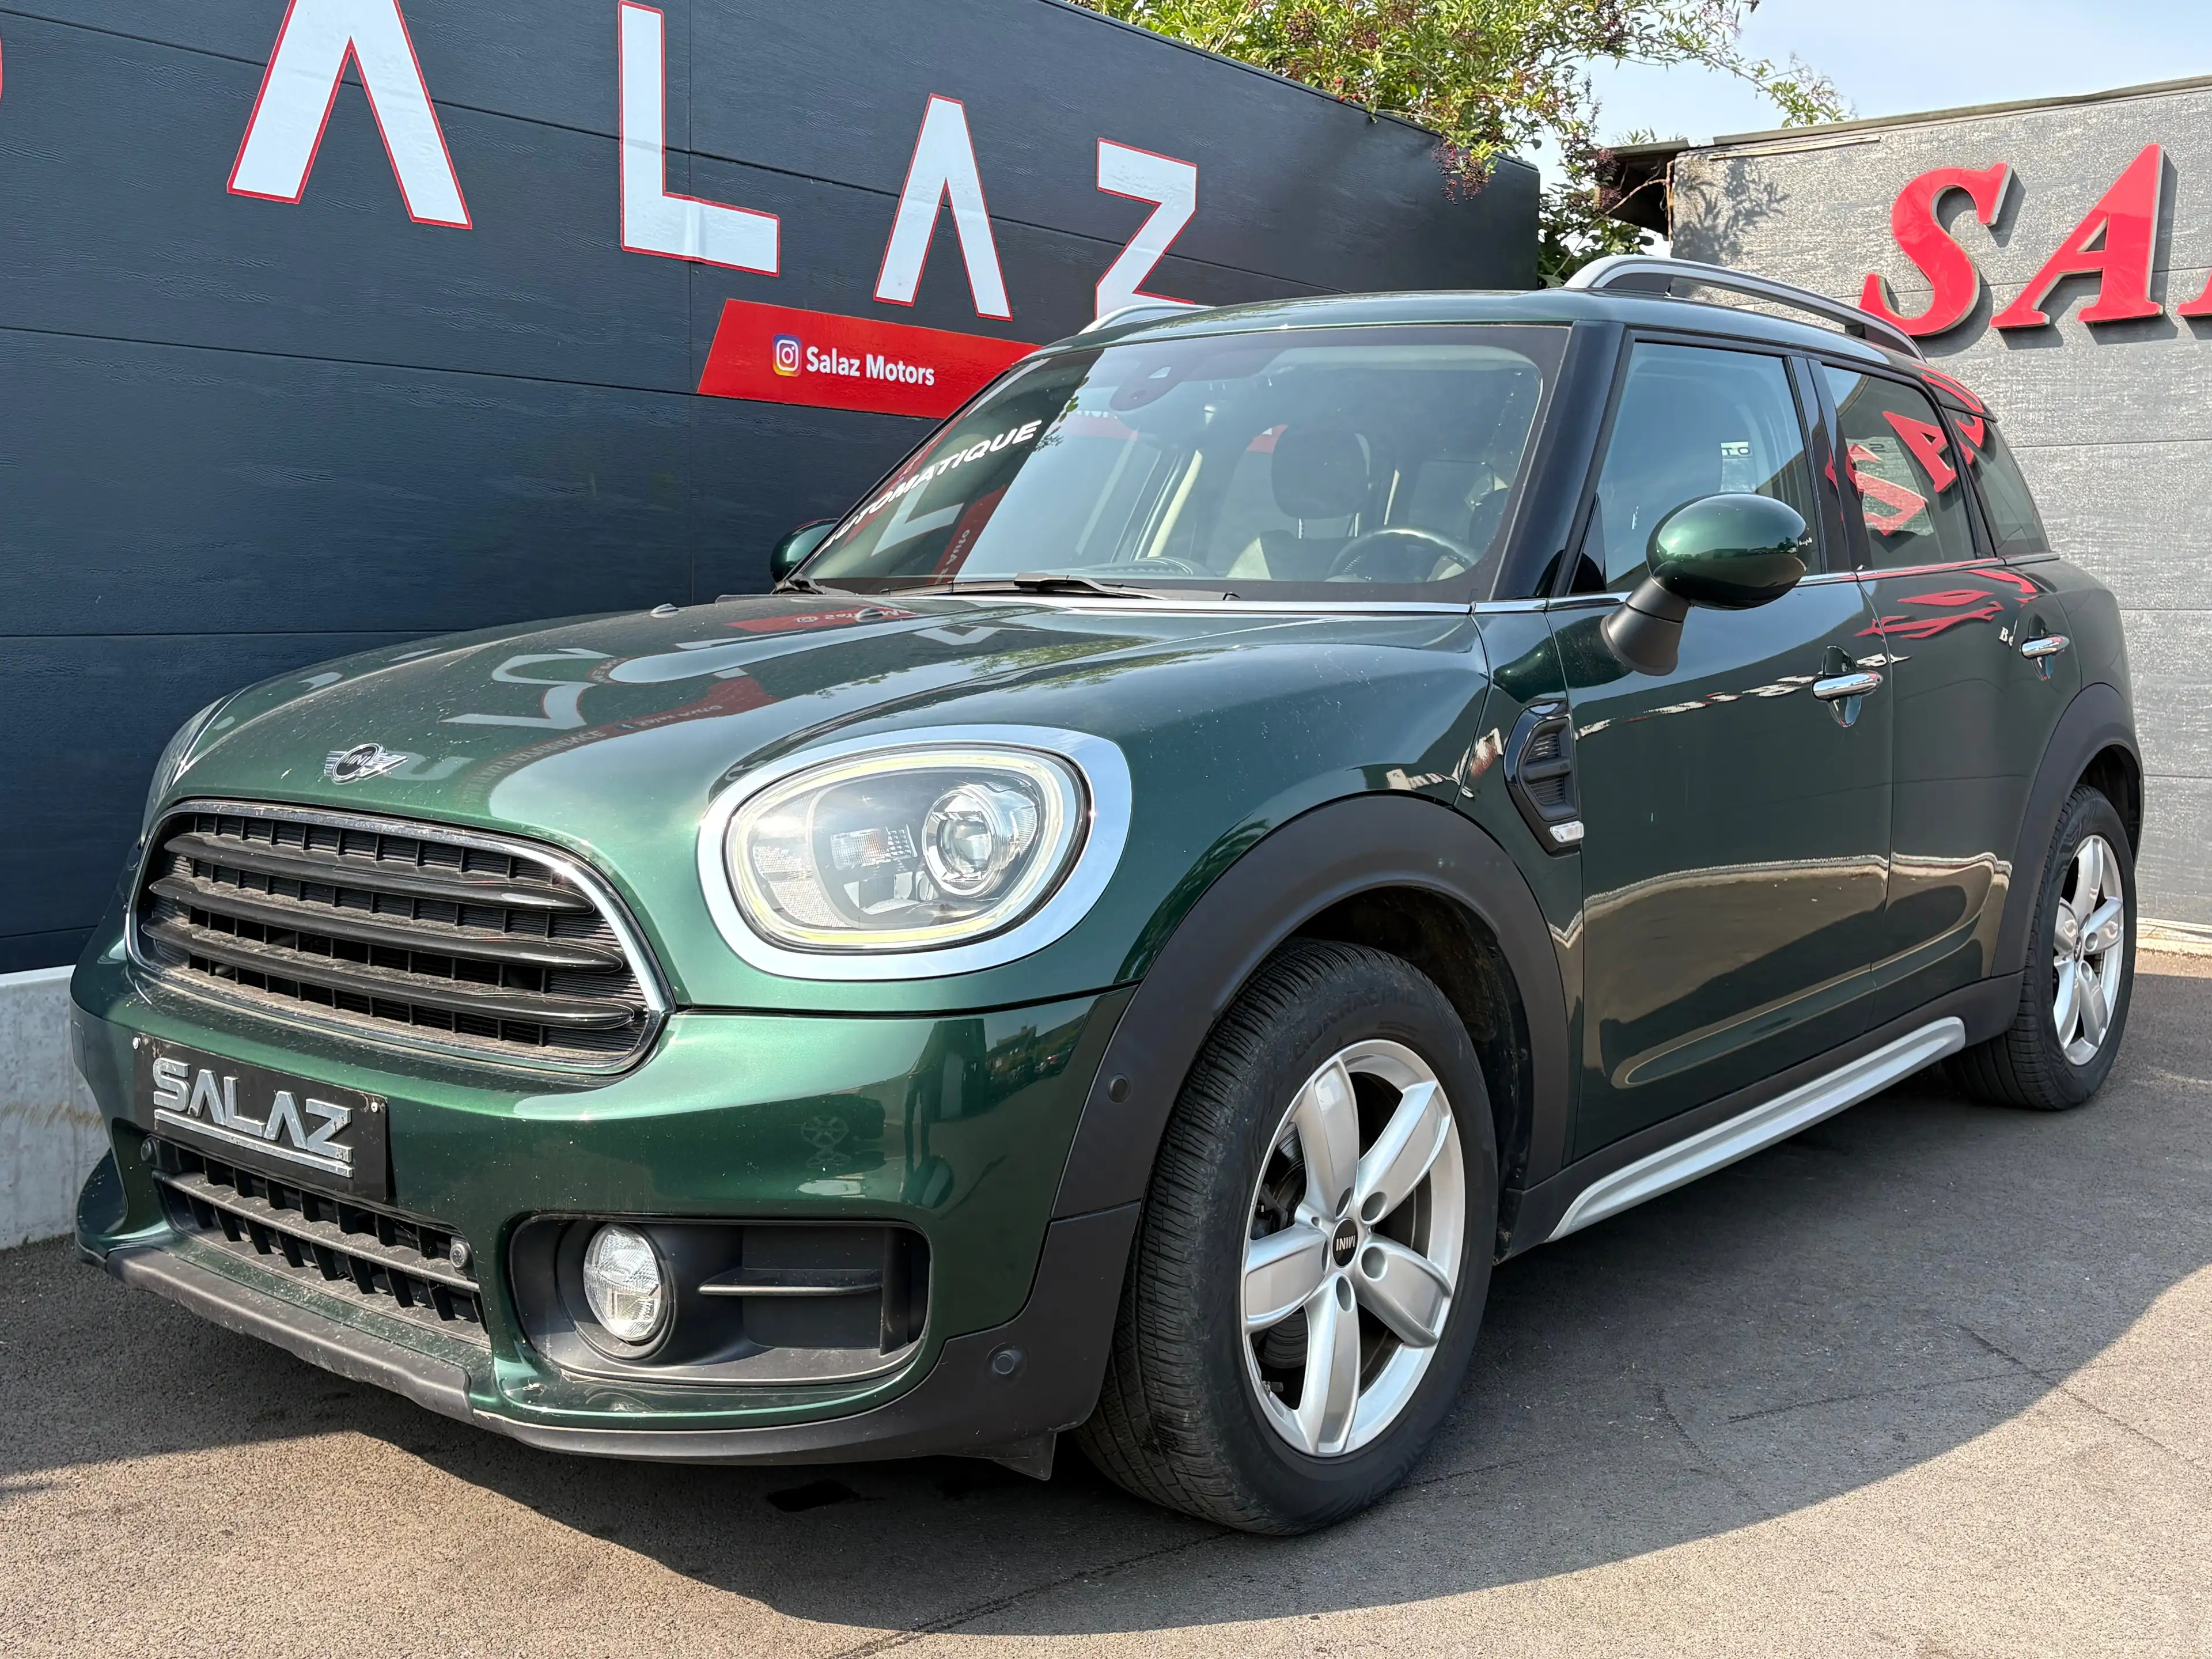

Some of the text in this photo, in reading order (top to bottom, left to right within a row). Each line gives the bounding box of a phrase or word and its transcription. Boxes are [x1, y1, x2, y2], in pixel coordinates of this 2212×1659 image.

[0, 0, 1218, 321] ALAZ
[1859, 143, 2212, 336] SA
[806, 345, 935, 387] Salaz Motors
[342, 754, 372, 767] MINI
[152, 1056, 354, 1163] SALAZ
[1335, 1234, 1356, 1252] MINI
